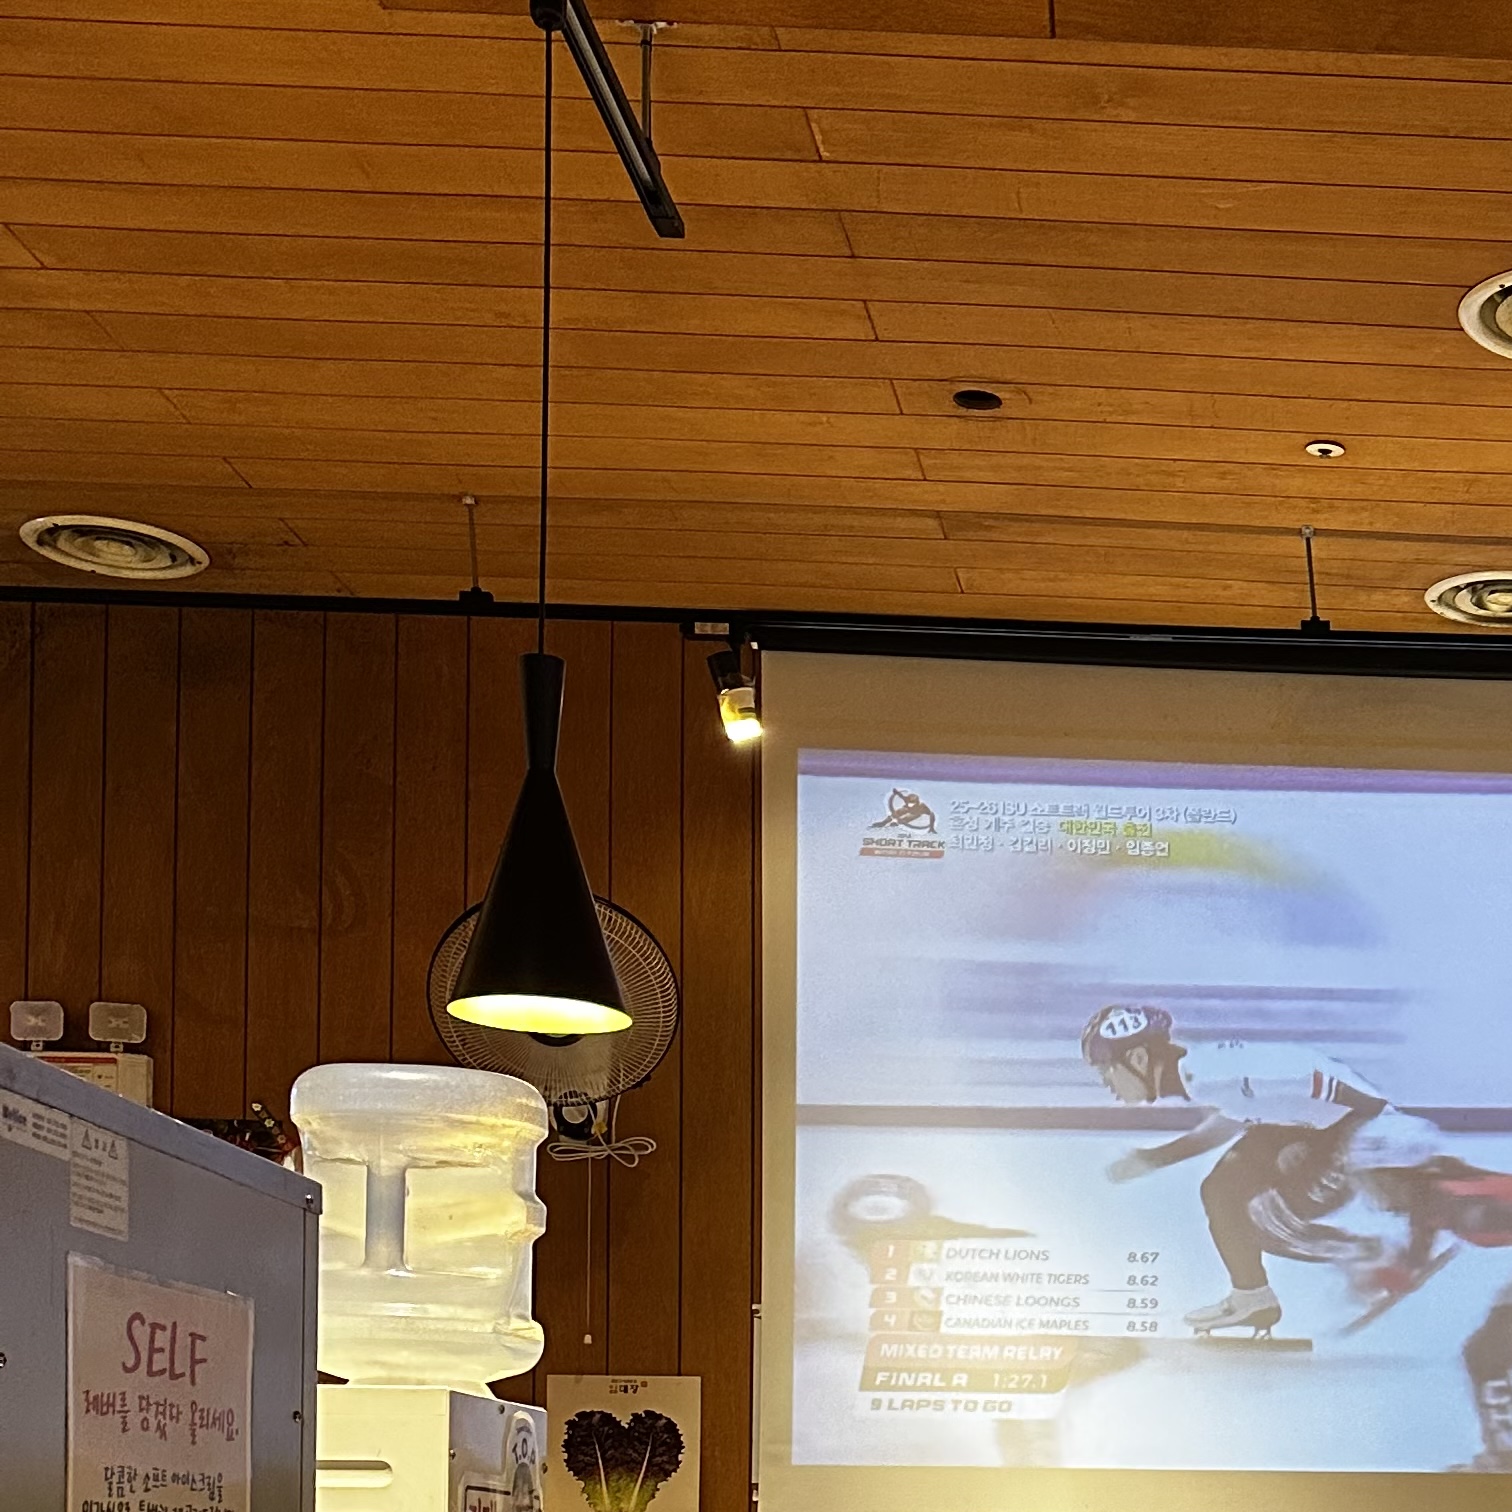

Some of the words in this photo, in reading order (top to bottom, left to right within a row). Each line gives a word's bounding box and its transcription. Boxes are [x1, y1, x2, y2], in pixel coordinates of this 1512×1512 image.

[1002, 801, 1027, 816] ISU
[1058, 820, 1118, 836] 대한민국
[863, 838, 904, 848] SHORT
[908, 839, 946, 849] TRACK
[1068, 839, 1112, 856] 이정민
[888, 1245, 895, 1258] 1
[945, 1248, 1000, 1262] DUTCH
[1004, 1249, 1050, 1262] LIONS
[1127, 1251, 1160, 1264] 8.67
[885, 1268, 897, 1281] 2
[944, 1272, 999, 1284] KOREAN
[1002, 1272, 1043, 1285] WHITE
[1047, 1273, 1089, 1286] TIGERS
[1126, 1274, 1159, 1287] 8.62
[885, 1291, 897, 1303] 3
[945, 1295, 1012, 1308] CHINESE
[1015, 1295, 1080, 1308] LOONGS
[1126, 1298, 1159, 1310] 8.59
[884, 1314, 897, 1327] 4
[944, 1317, 1013, 1330] CANADIAN
[1015, 1318, 1036, 1330] ICE
[1038, 1319, 1090, 1332] MAPLES
[1126, 1321, 1158, 1333] 8.58
[121, 1311, 208, 1387] SELF
[880, 1343, 944, 1360] MIXED
[947, 1345, 999, 1361] TEAM
[1001, 1345, 1063, 1361] RELAY
[875, 1372, 946, 1387] FINAL
[952, 1373, 969, 1387] A
[992, 1373, 1048, 1389] 1:27.1
[82, 1389, 131, 1434] 레버를
[887, 1398, 945, 1411] LAPS
[951, 1399, 979, 1412] TO
[983, 1400, 1013, 1413] GO
[104, 1466, 138, 1499] 달콤한
[142, 1467, 168, 1493] 소프트
[171, 1470, 224, 1504] 아이스크림을
